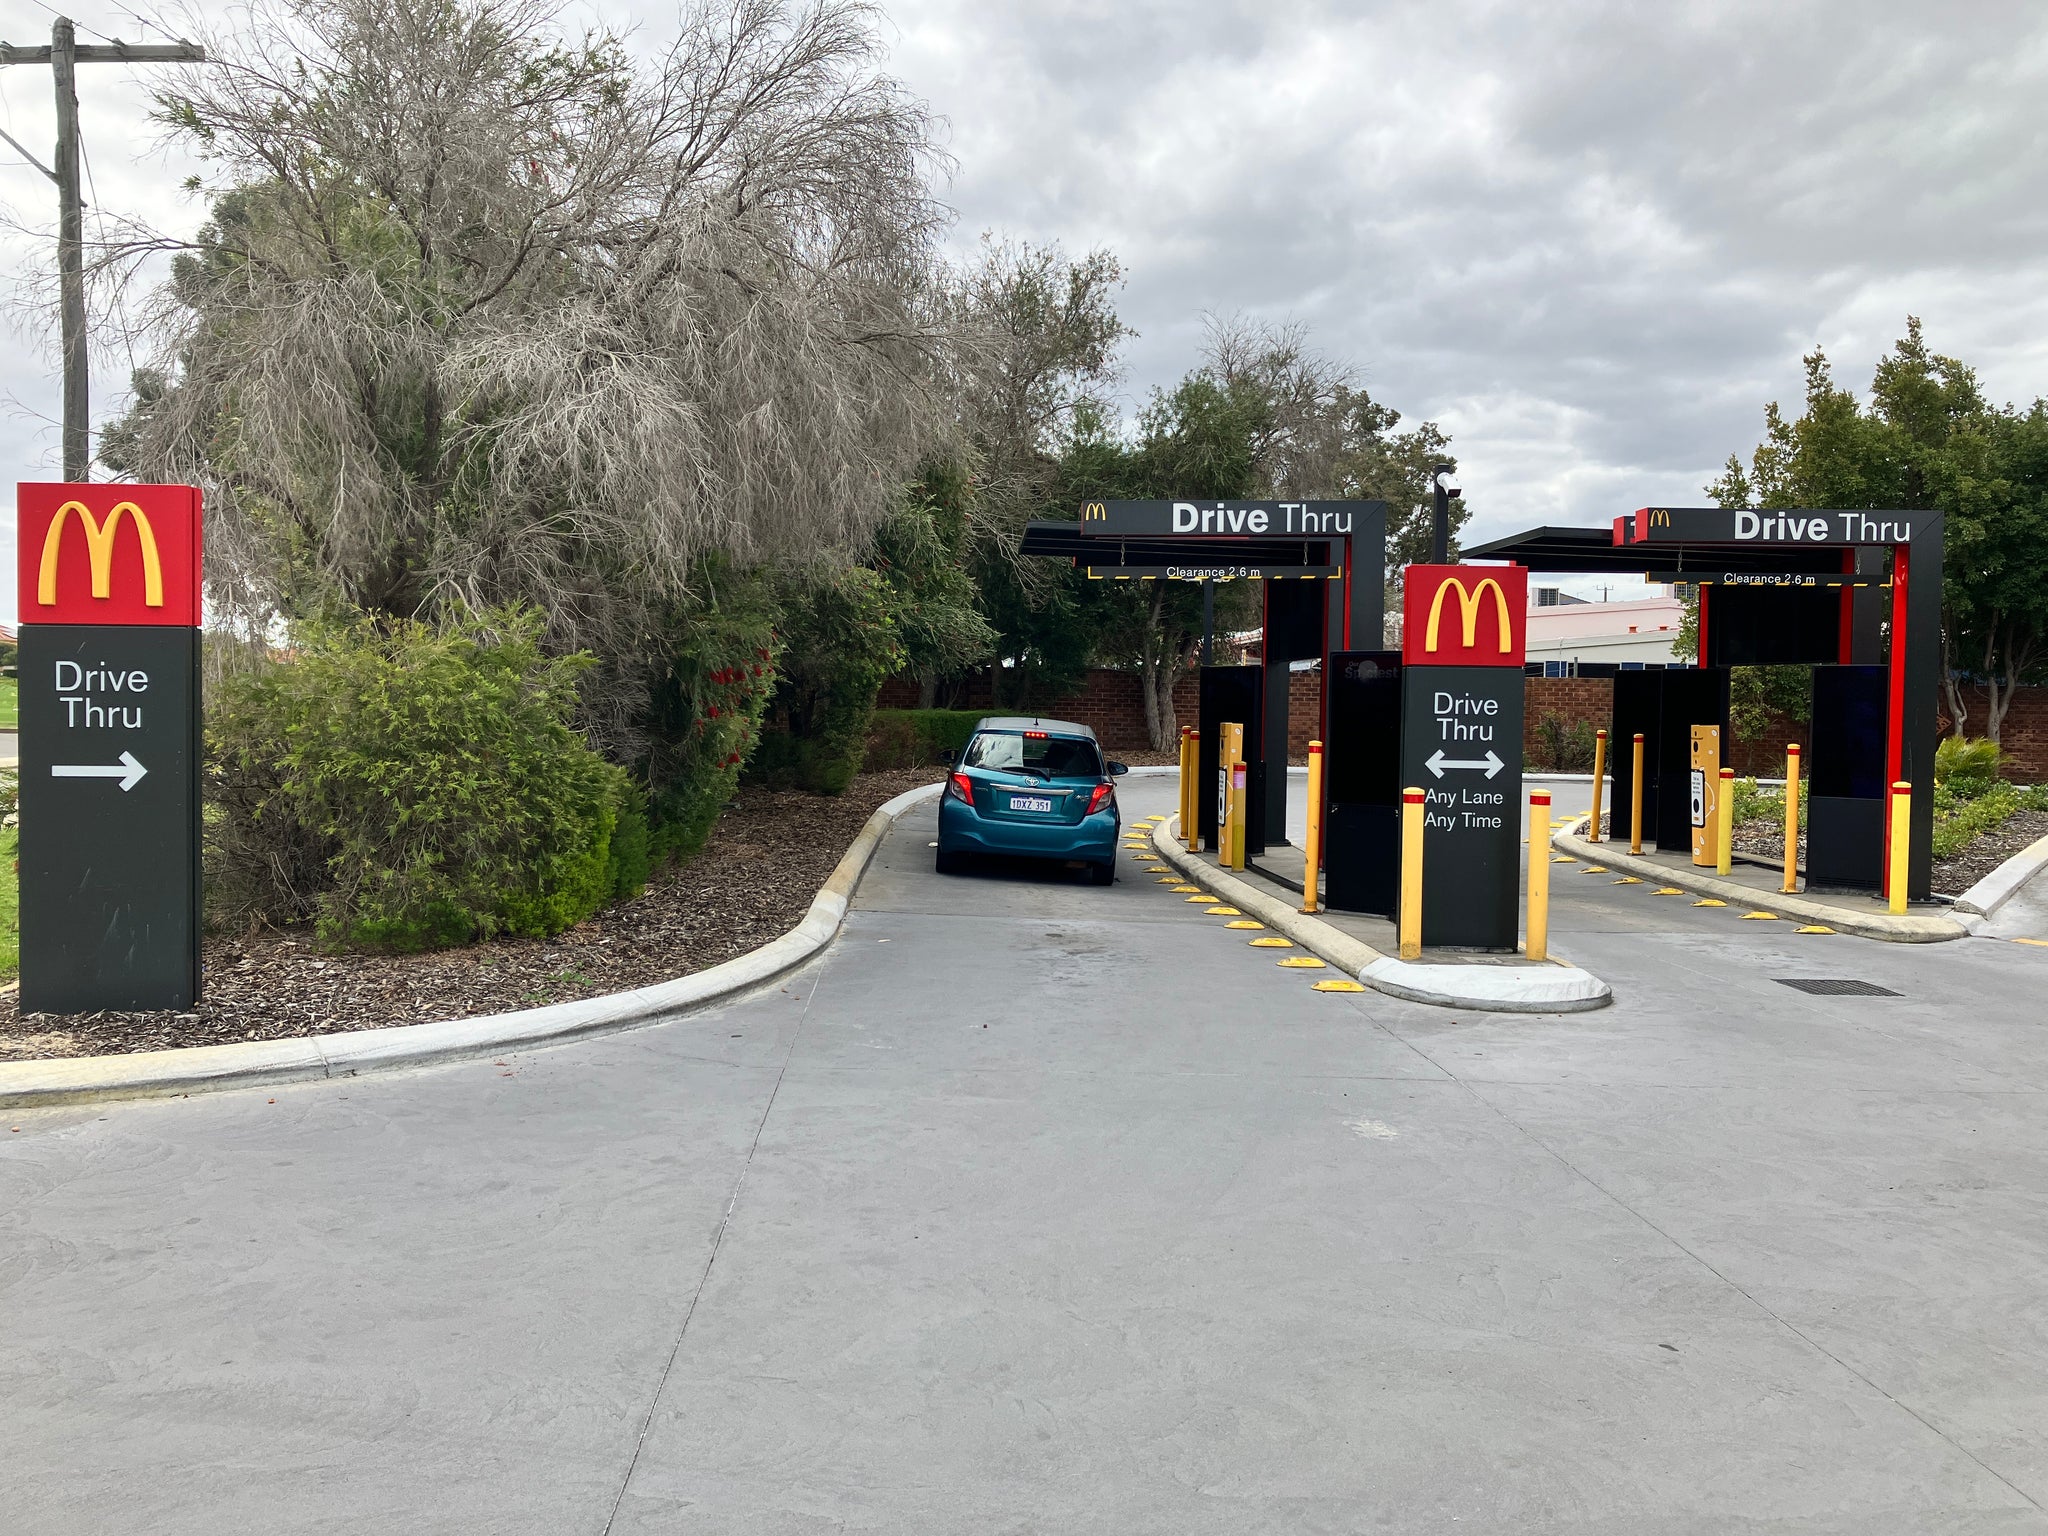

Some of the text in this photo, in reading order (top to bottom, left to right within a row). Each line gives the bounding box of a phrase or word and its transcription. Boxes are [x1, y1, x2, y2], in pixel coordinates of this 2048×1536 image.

[1172, 503, 1352, 533] Drive Thru
[1734, 511, 1911, 542] Drive Thru
[1166, 566, 1261, 577] Clearance 2.6 m
[1724, 572, 1816, 585] Clearance 2.6 m
[55, 660, 149, 693] Drive
[59, 697, 142, 729] Thru
[1434, 692, 1499, 716] Drive
[1436, 718, 1493, 741] Thru
[1012, 800, 1049, 811] 1DXZ 351
[1424, 788, 1504, 807] Any Lane
[1424, 812, 1502, 831] Any Time
